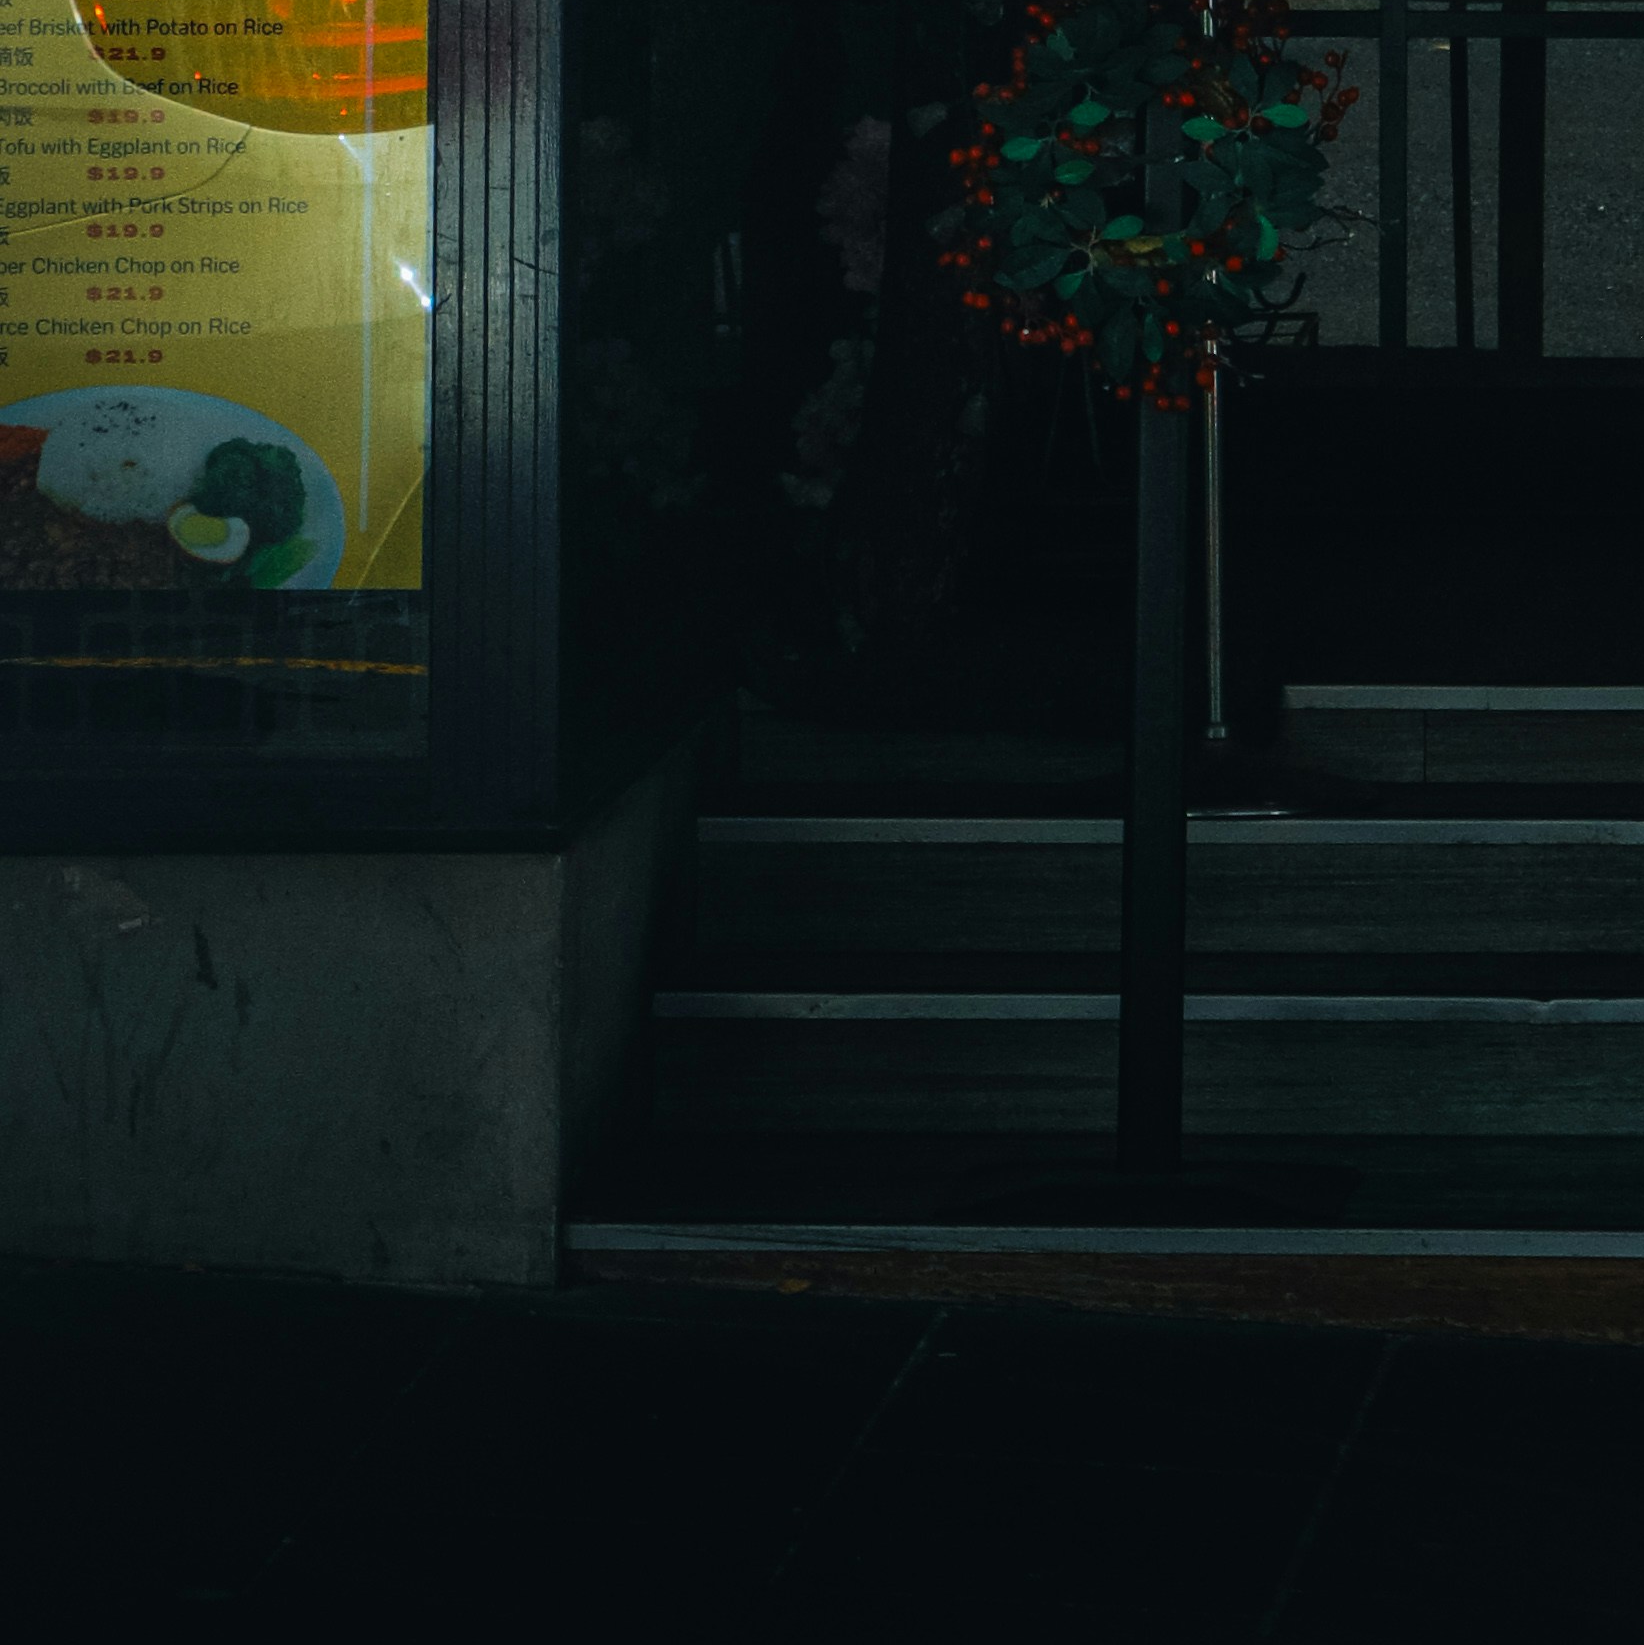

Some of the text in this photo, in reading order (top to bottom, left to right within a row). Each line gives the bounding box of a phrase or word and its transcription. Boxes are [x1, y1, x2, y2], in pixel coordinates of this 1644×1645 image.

[29, 19, 95, 36] Brisket
[101, 19, 140, 36] with
[146, 19, 210, 36] Potato
[215, 22, 238, 36] on
[244, 19, 284, 36] Rice
[92, 45, 166, 61] $21.9
[76, 78, 117, 96] with
[122, 78, 163, 96] Beef
[168, 82, 193, 96] on
[198, 78, 239, 96] Rice
[88, 108, 165, 124] $19.9
[41, 138, 81, 155] with
[87, 138, 172, 159] Eggplant
[178, 141, 201, 155] on
[206, 138, 247, 155] Rice
[87, 166, 164, 181] $19.9
[82, 197, 122, 214] with
[128, 197, 173, 214] Pork
[178, 197, 231, 218] Strips
[238, 201, 262, 214] on
[269, 197, 309, 214] Rice
[86, 224, 164, 239] $19.9
[32, 257, 109, 274] Chicken
[115, 257, 166, 279] Chop
[171, 261, 194, 274] on
[200, 257, 240, 274] Rice
[86, 286, 163, 301] $21.9
[35, 318, 115, 336] Chicken
[120, 318, 172, 340] Chop
[178, 321, 202, 336] on
[208, 318, 251, 335] Rice
[85, 349, 163, 365] $21.9
